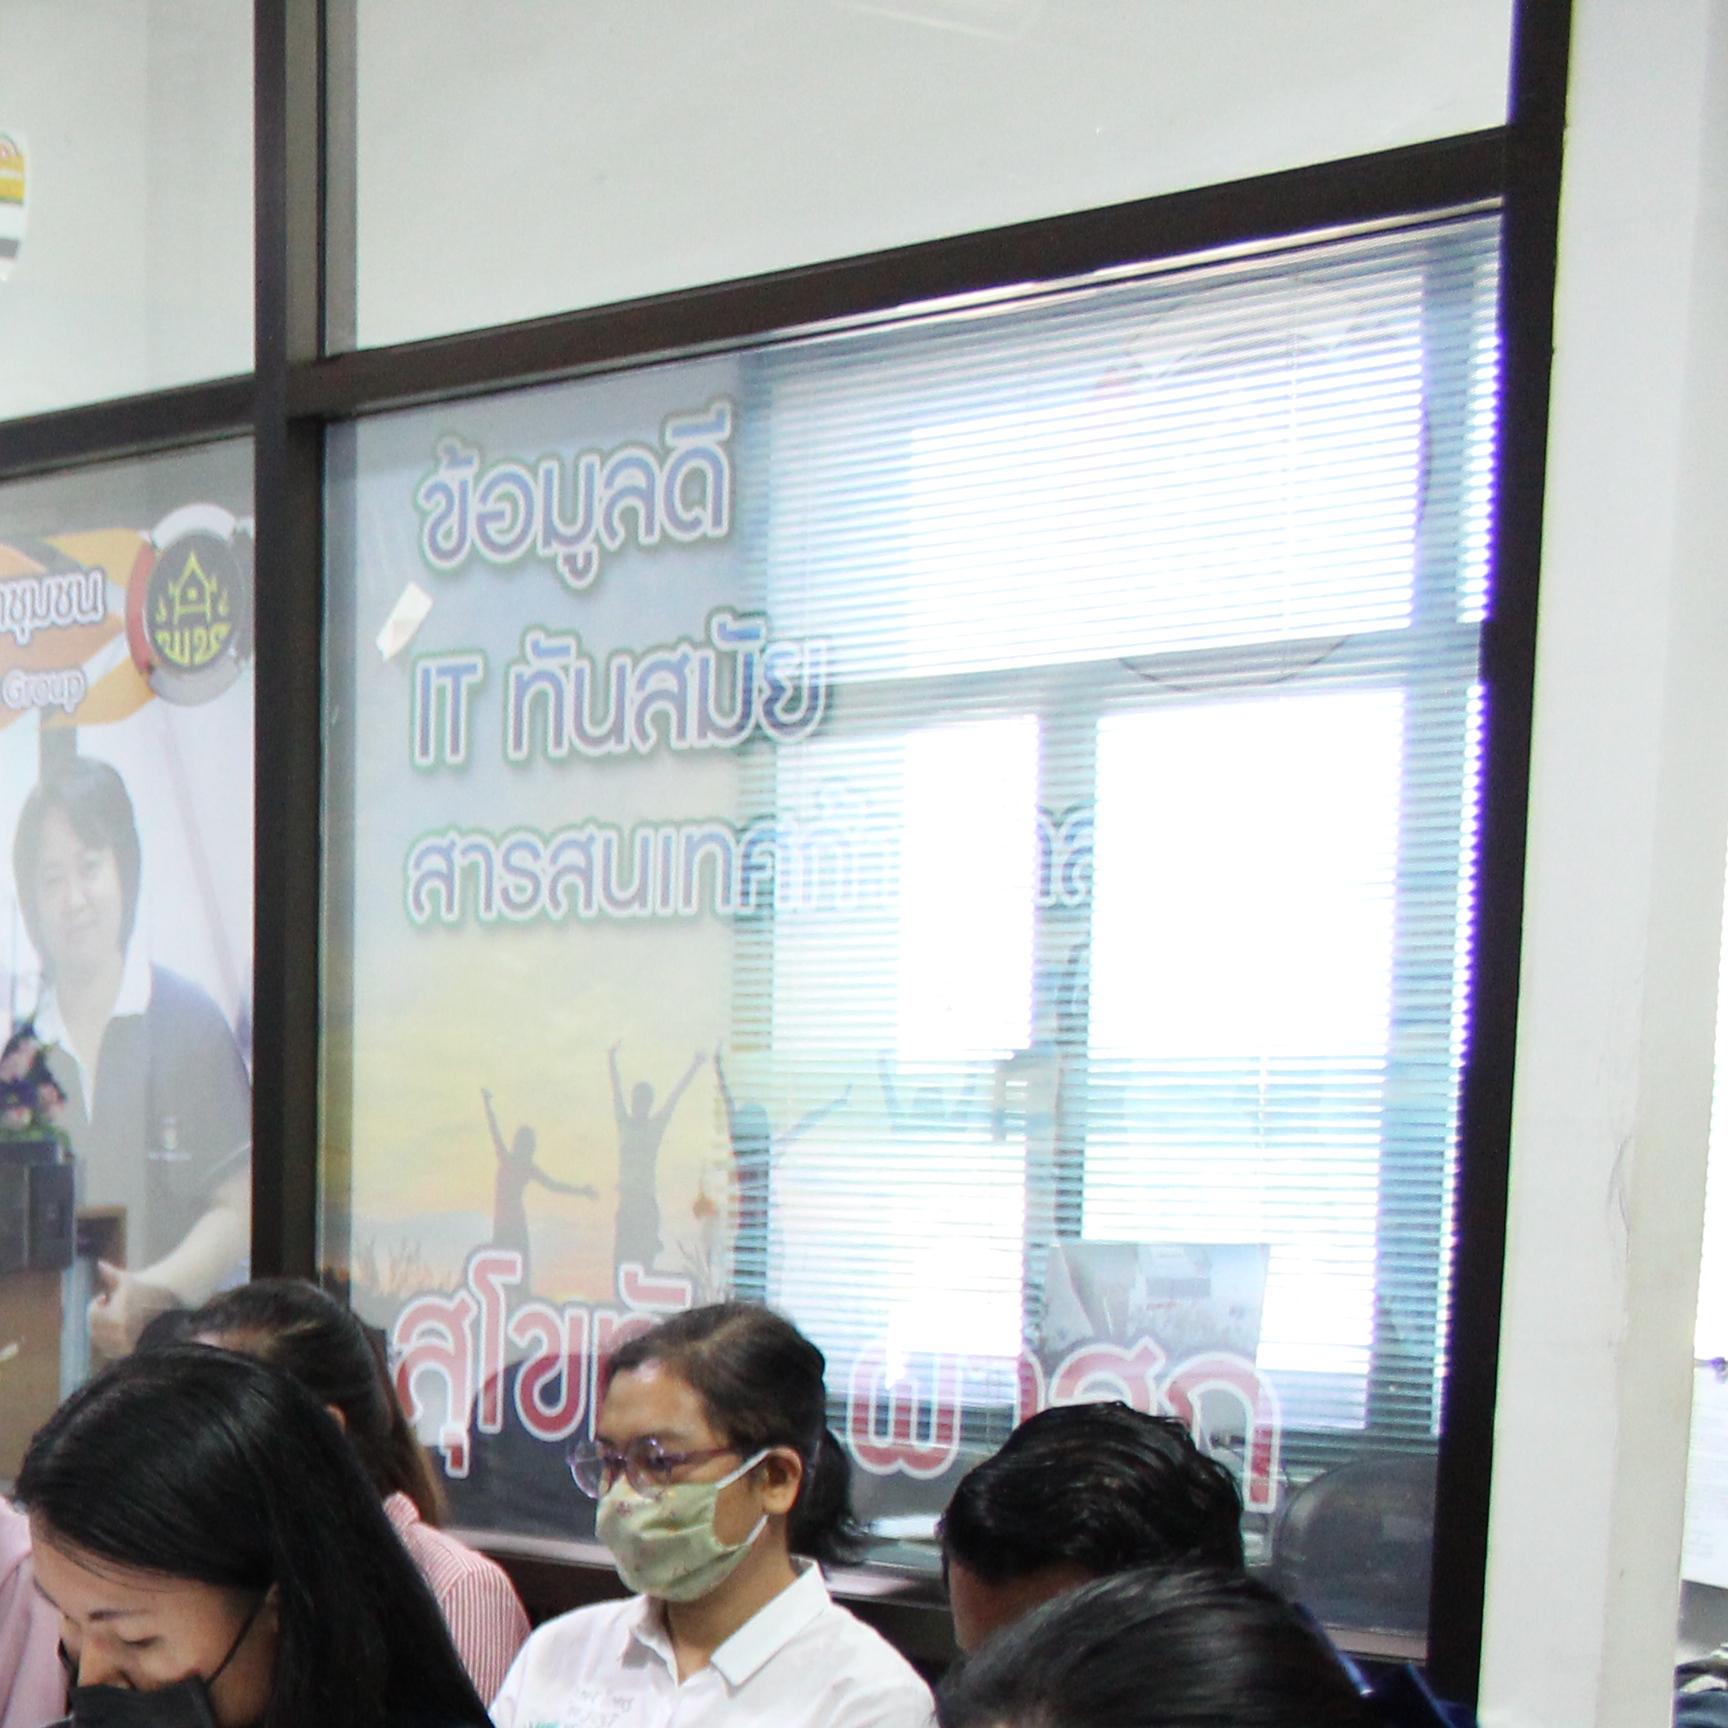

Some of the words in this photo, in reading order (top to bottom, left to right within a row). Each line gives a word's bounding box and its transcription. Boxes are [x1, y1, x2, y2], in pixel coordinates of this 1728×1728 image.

[418, 403, 731, 588] ข้อมูลดี
[1, 668, 87, 714] Group
[415, 656, 483, 765] IT
[508, 613, 828, 762] ทันสมัย
